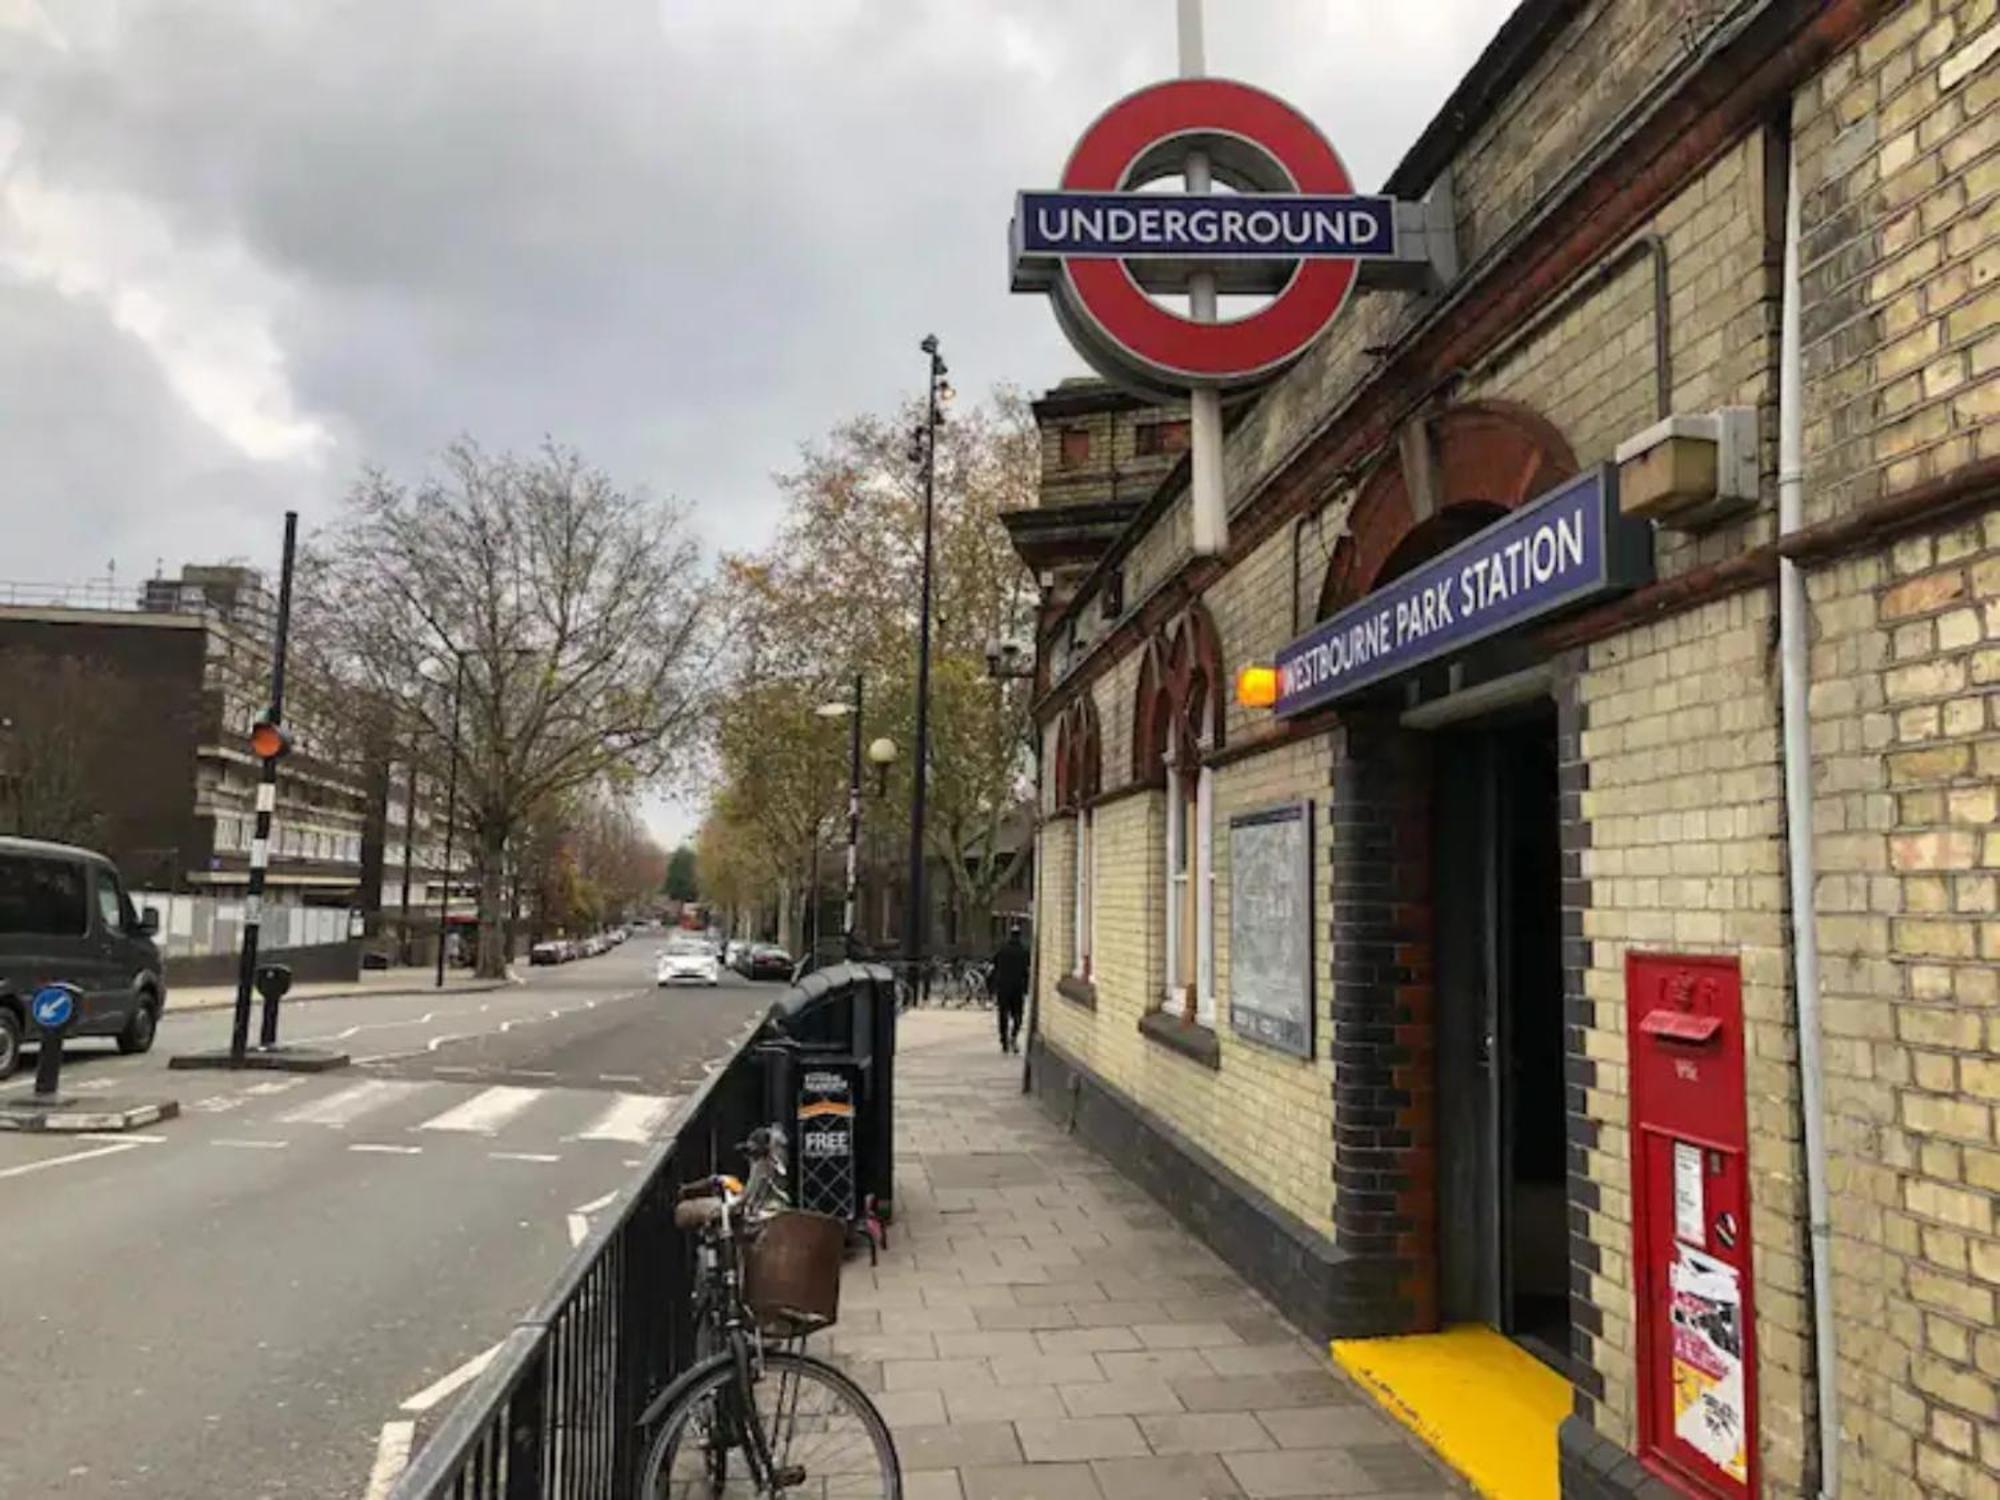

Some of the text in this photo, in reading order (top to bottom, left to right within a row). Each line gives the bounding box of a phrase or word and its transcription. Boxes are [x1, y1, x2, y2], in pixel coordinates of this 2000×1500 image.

[1037, 206, 1379, 245] UNDERGROUND
[1282, 508, 1583, 696] WESTBOURNE PARK STATION
[805, 1131, 849, 1152] FREE
